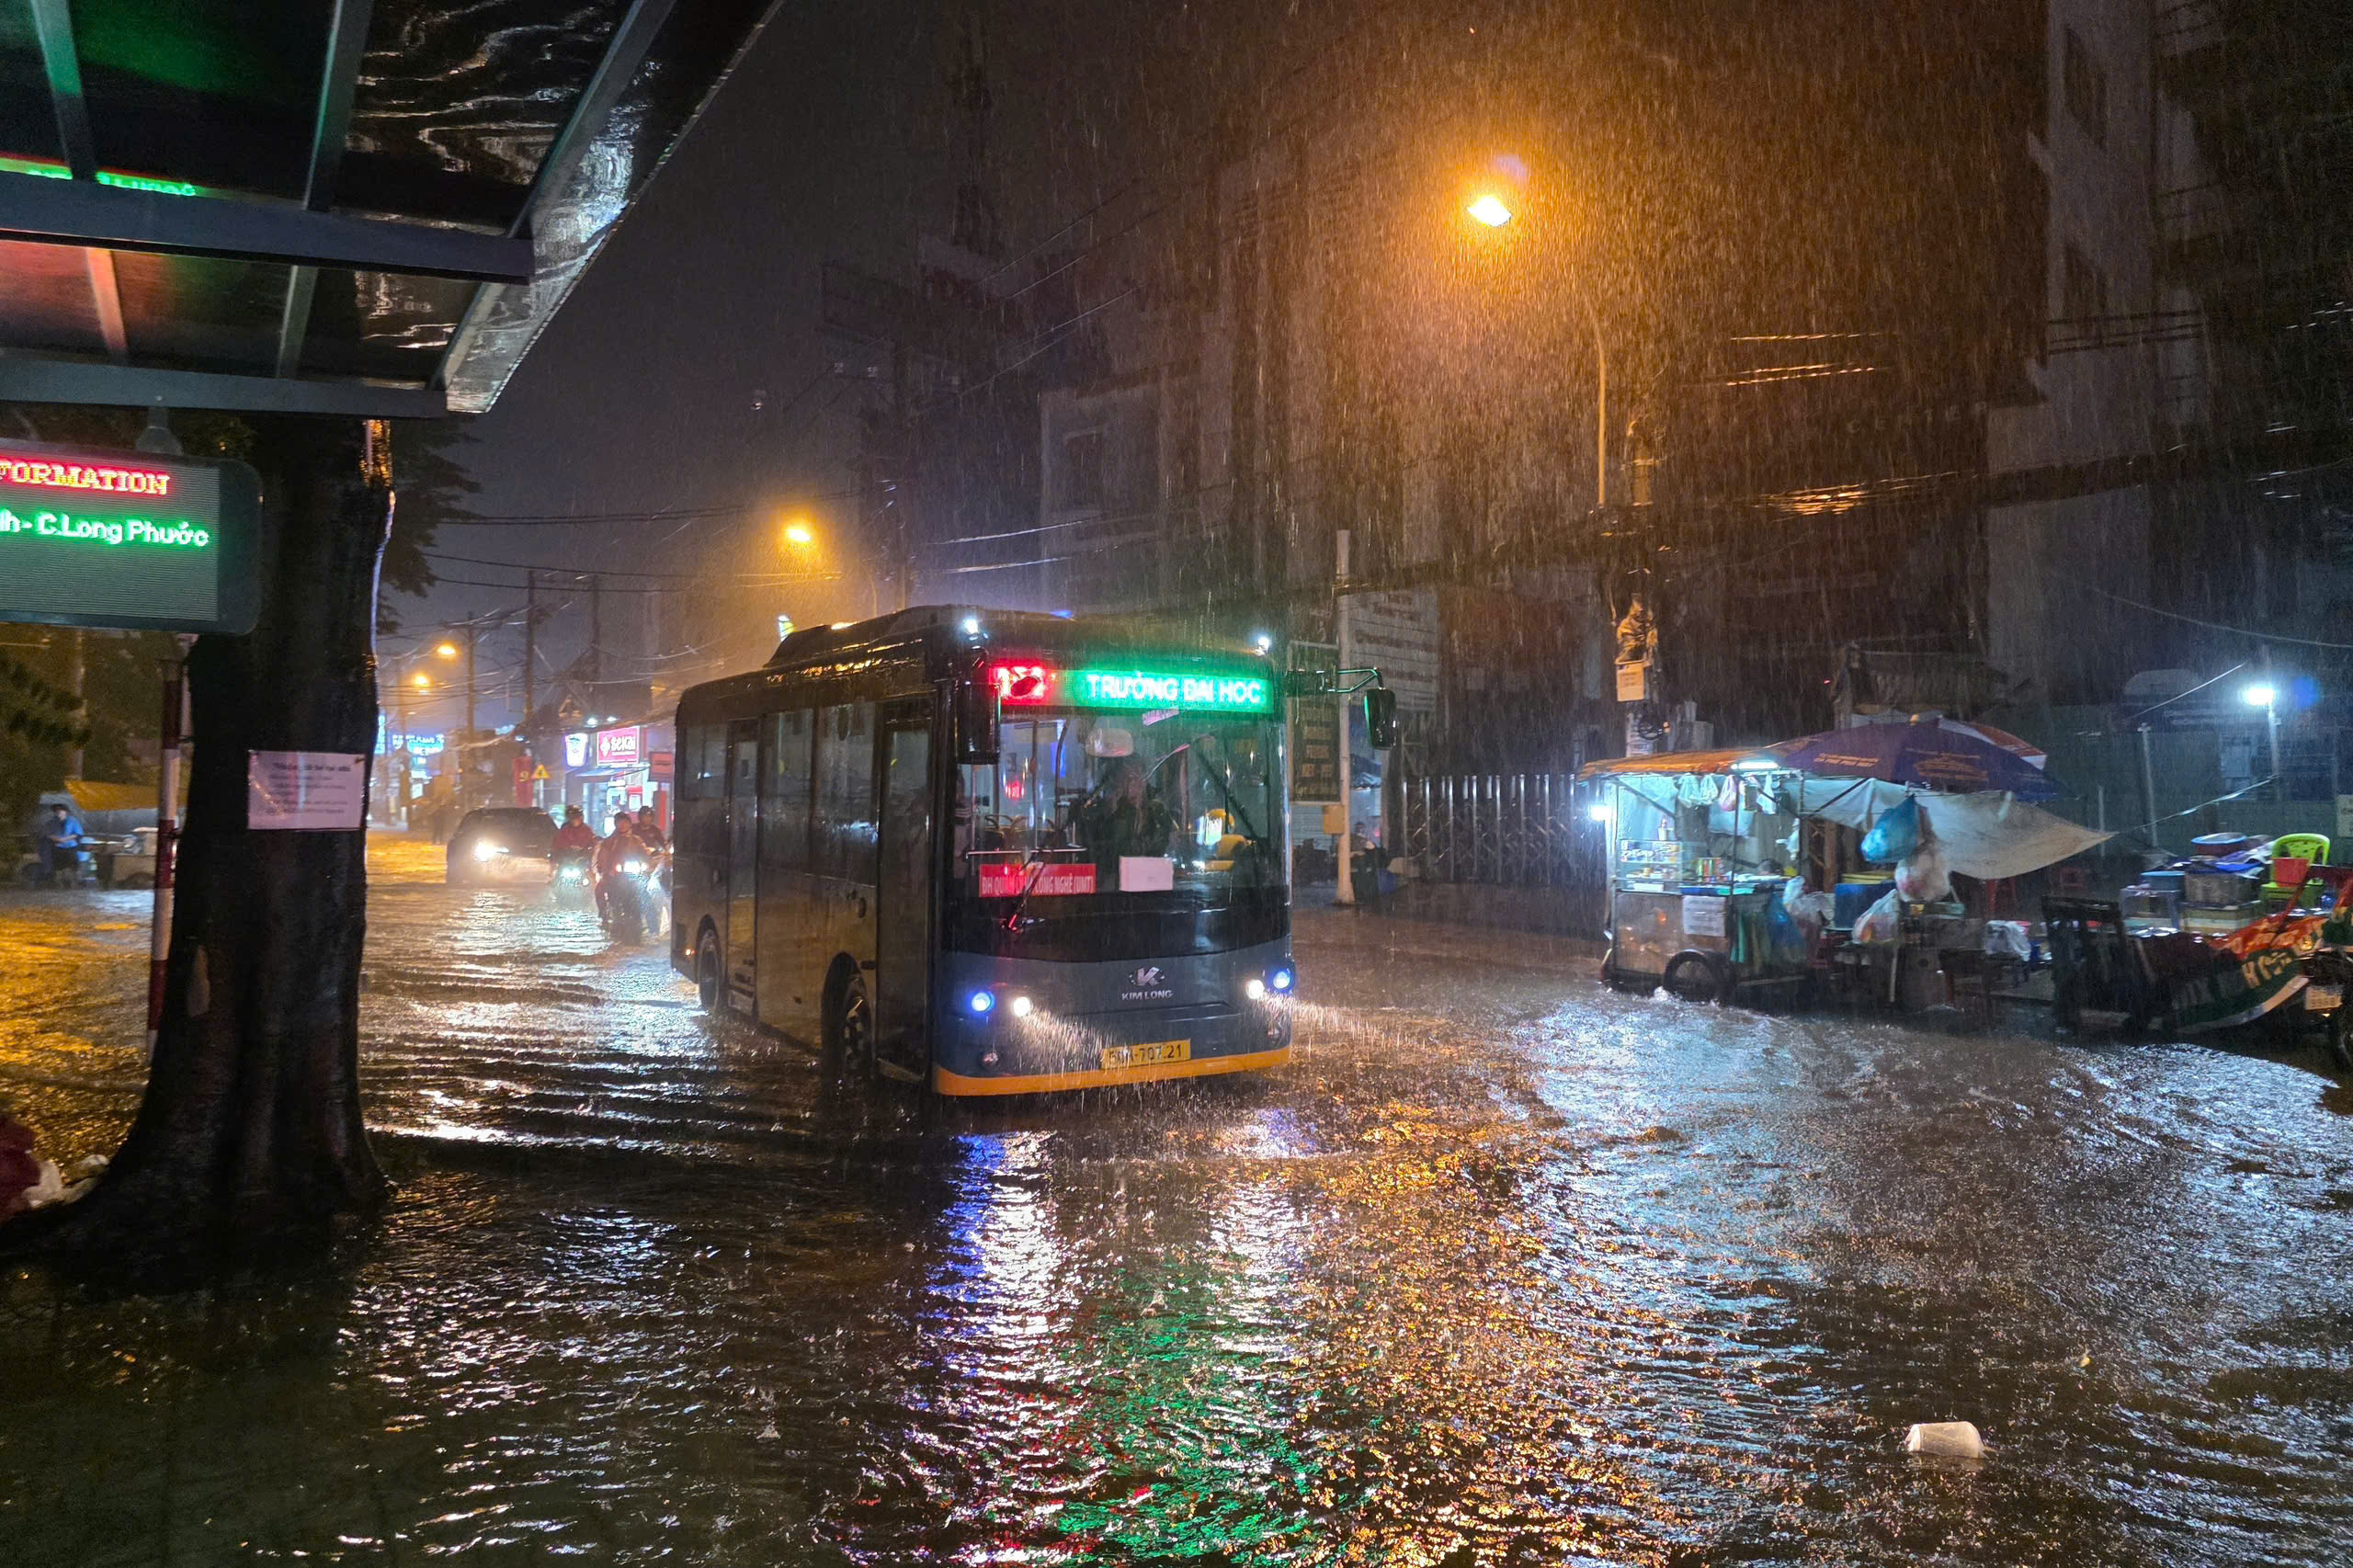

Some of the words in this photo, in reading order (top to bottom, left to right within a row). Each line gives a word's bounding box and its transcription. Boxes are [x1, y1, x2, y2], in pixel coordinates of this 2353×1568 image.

[125, 519, 210, 547] Phước
[1121, 992, 1142, 1001] KIM
[1144, 989, 1174, 1000] LONG
